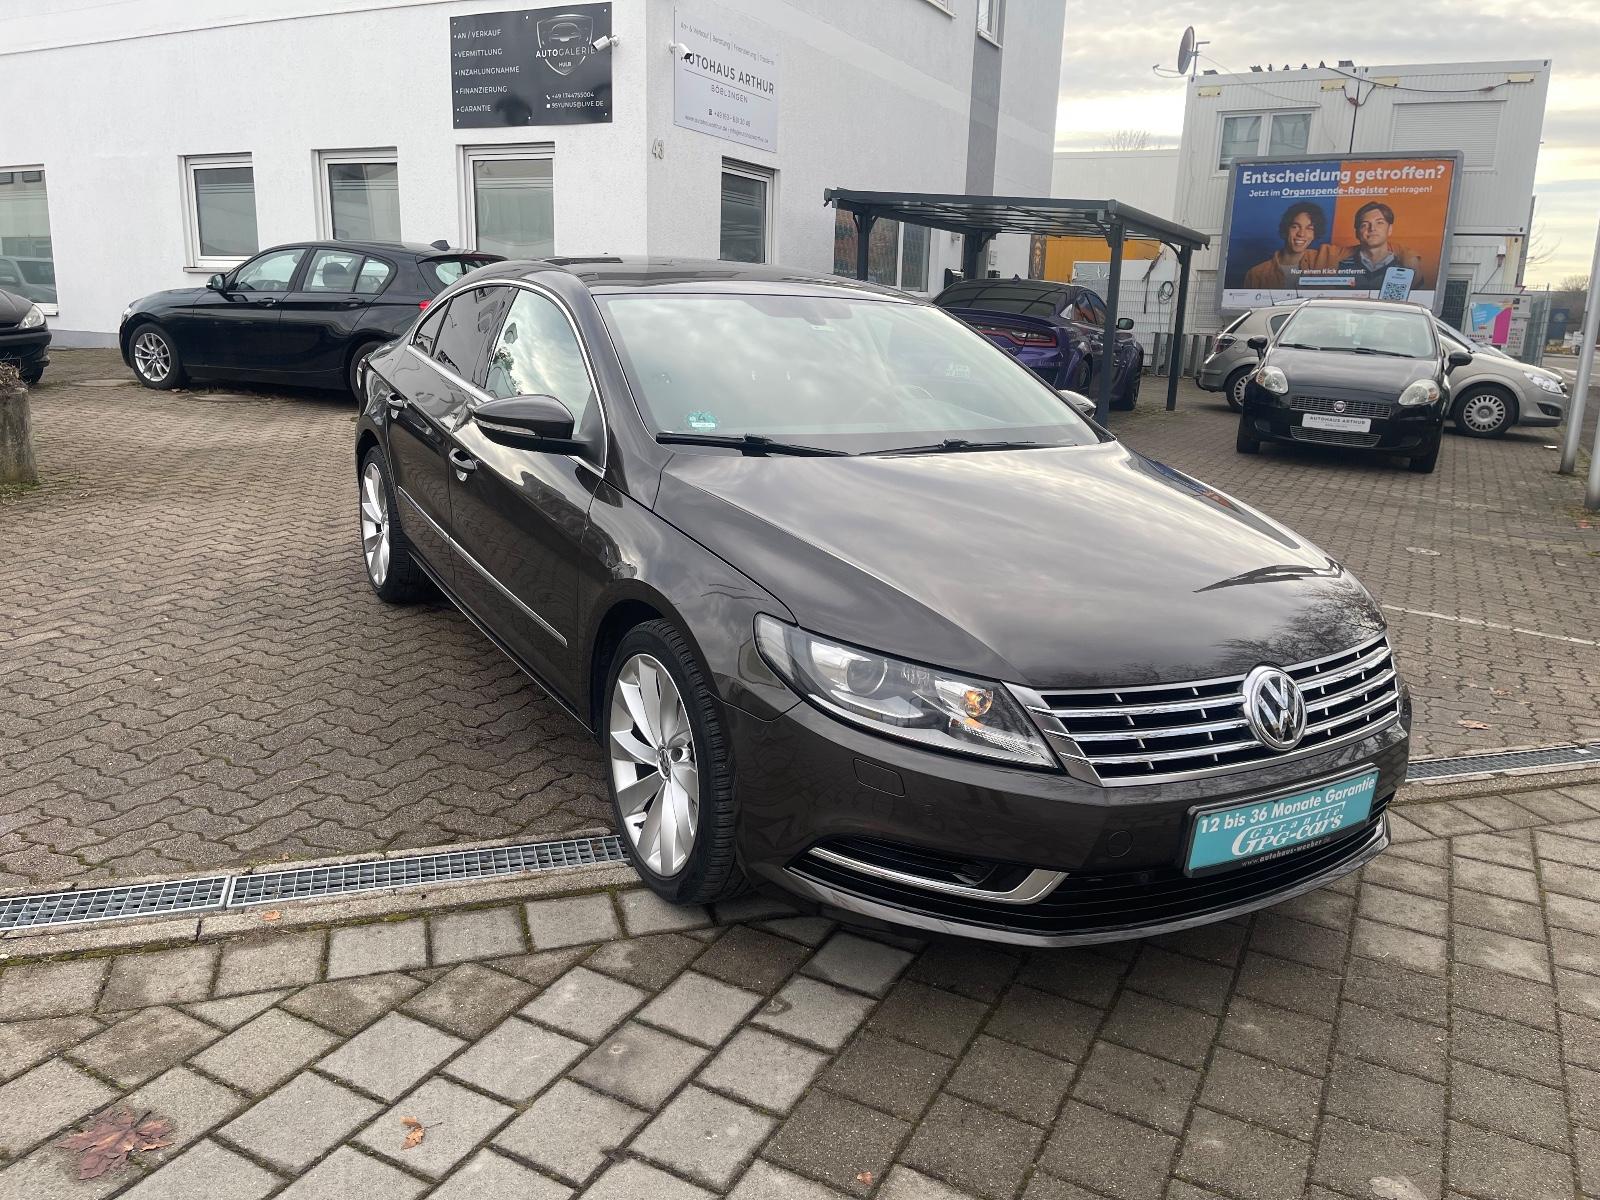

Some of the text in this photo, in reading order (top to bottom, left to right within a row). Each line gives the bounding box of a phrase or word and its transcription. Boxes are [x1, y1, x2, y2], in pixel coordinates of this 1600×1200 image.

[457, 31, 467, 39] AN
[471, 29, 502, 38] VERKAUF
[457, 48, 503, 58] VERMITTLUNG
[458, 66, 520, 76] INZAHLUNGNAHME
[738, 71, 775, 95] ARTHUR
[459, 86, 508, 95] FINANZIERUNG
[711, 84, 748, 103] BÖBLINGEN
[460, 105, 492, 113] GARANTIE
[651, 136, 665, 160] 43
[1242, 165, 1446, 184] Entscheidung getroffen?
[1248, 185, 1433, 197] Jetzt im Organspende-Register eintragen!
[1201, 776, 1376, 834] 12 bis 36 Monate Garantie
